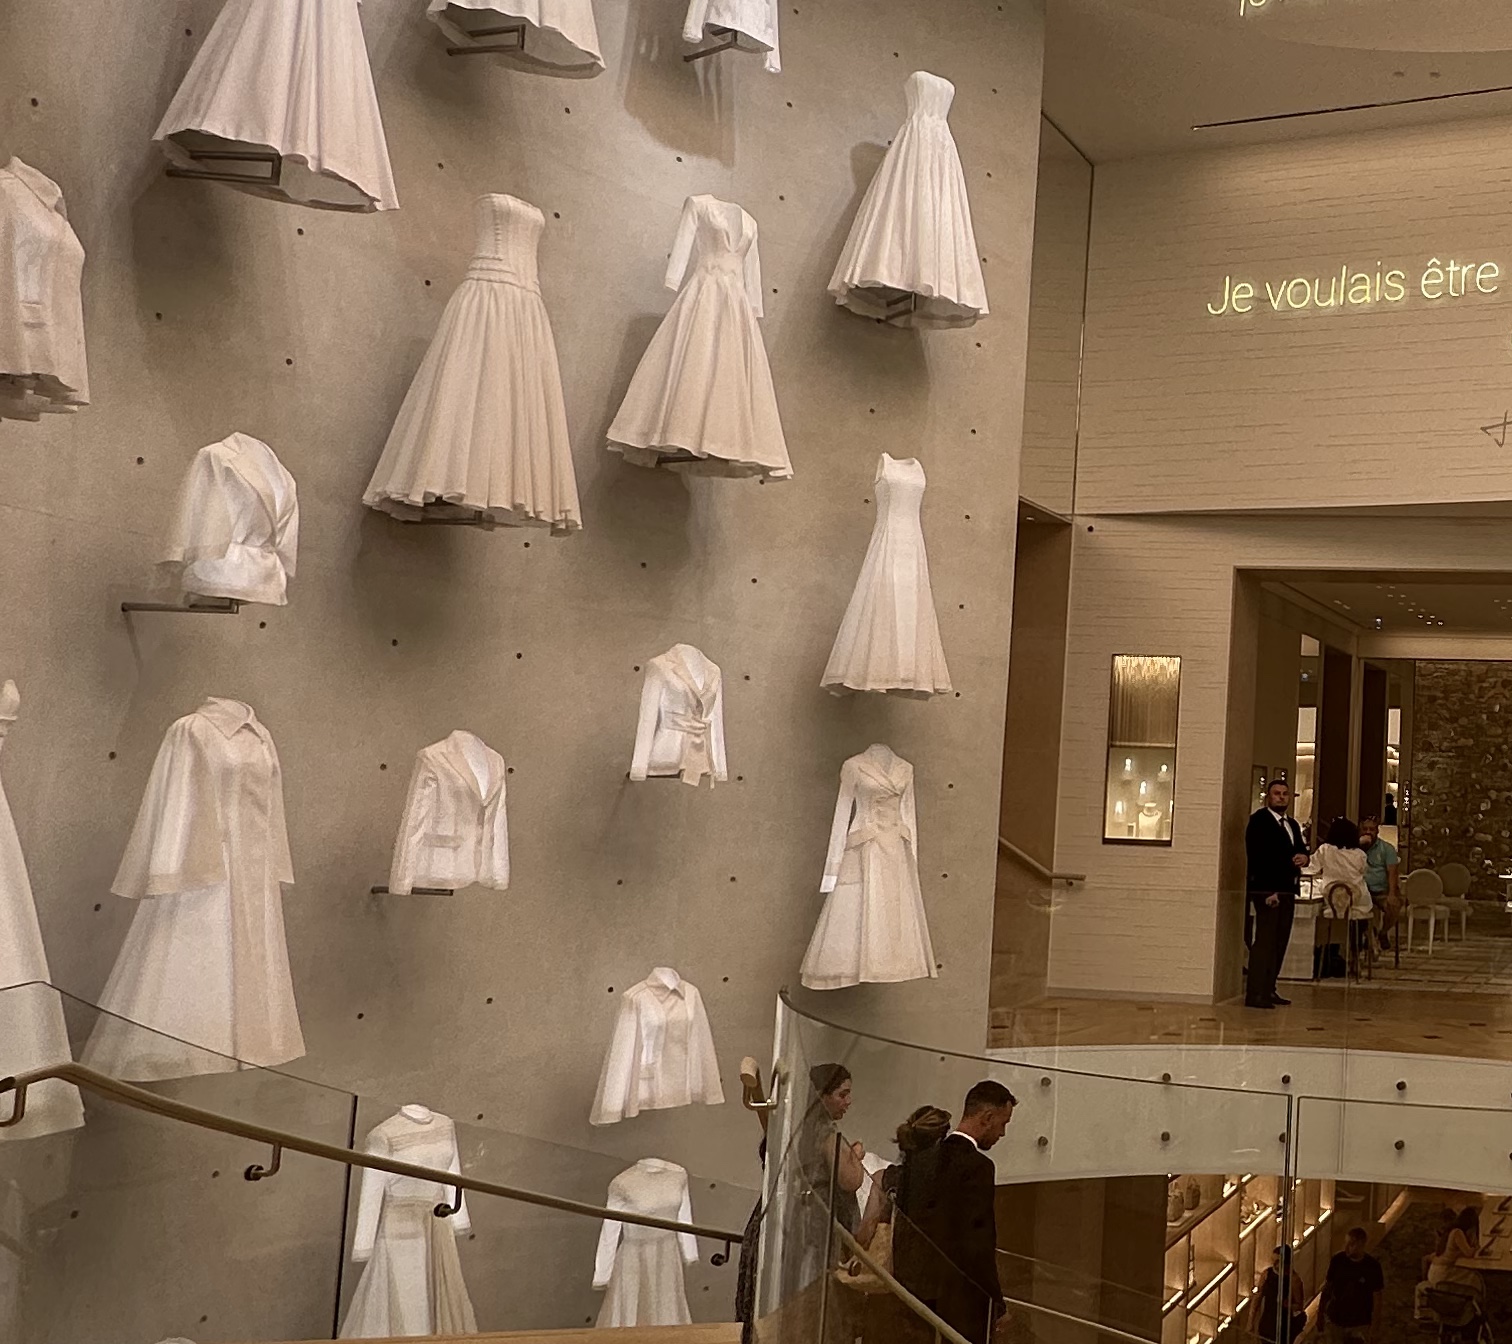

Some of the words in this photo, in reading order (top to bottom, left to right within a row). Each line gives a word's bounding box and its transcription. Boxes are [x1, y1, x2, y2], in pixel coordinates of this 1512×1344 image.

[1206, 275, 1254, 315] Je
[1265, 260, 1406, 311] voulais
[1420, 256, 1500, 299] être
